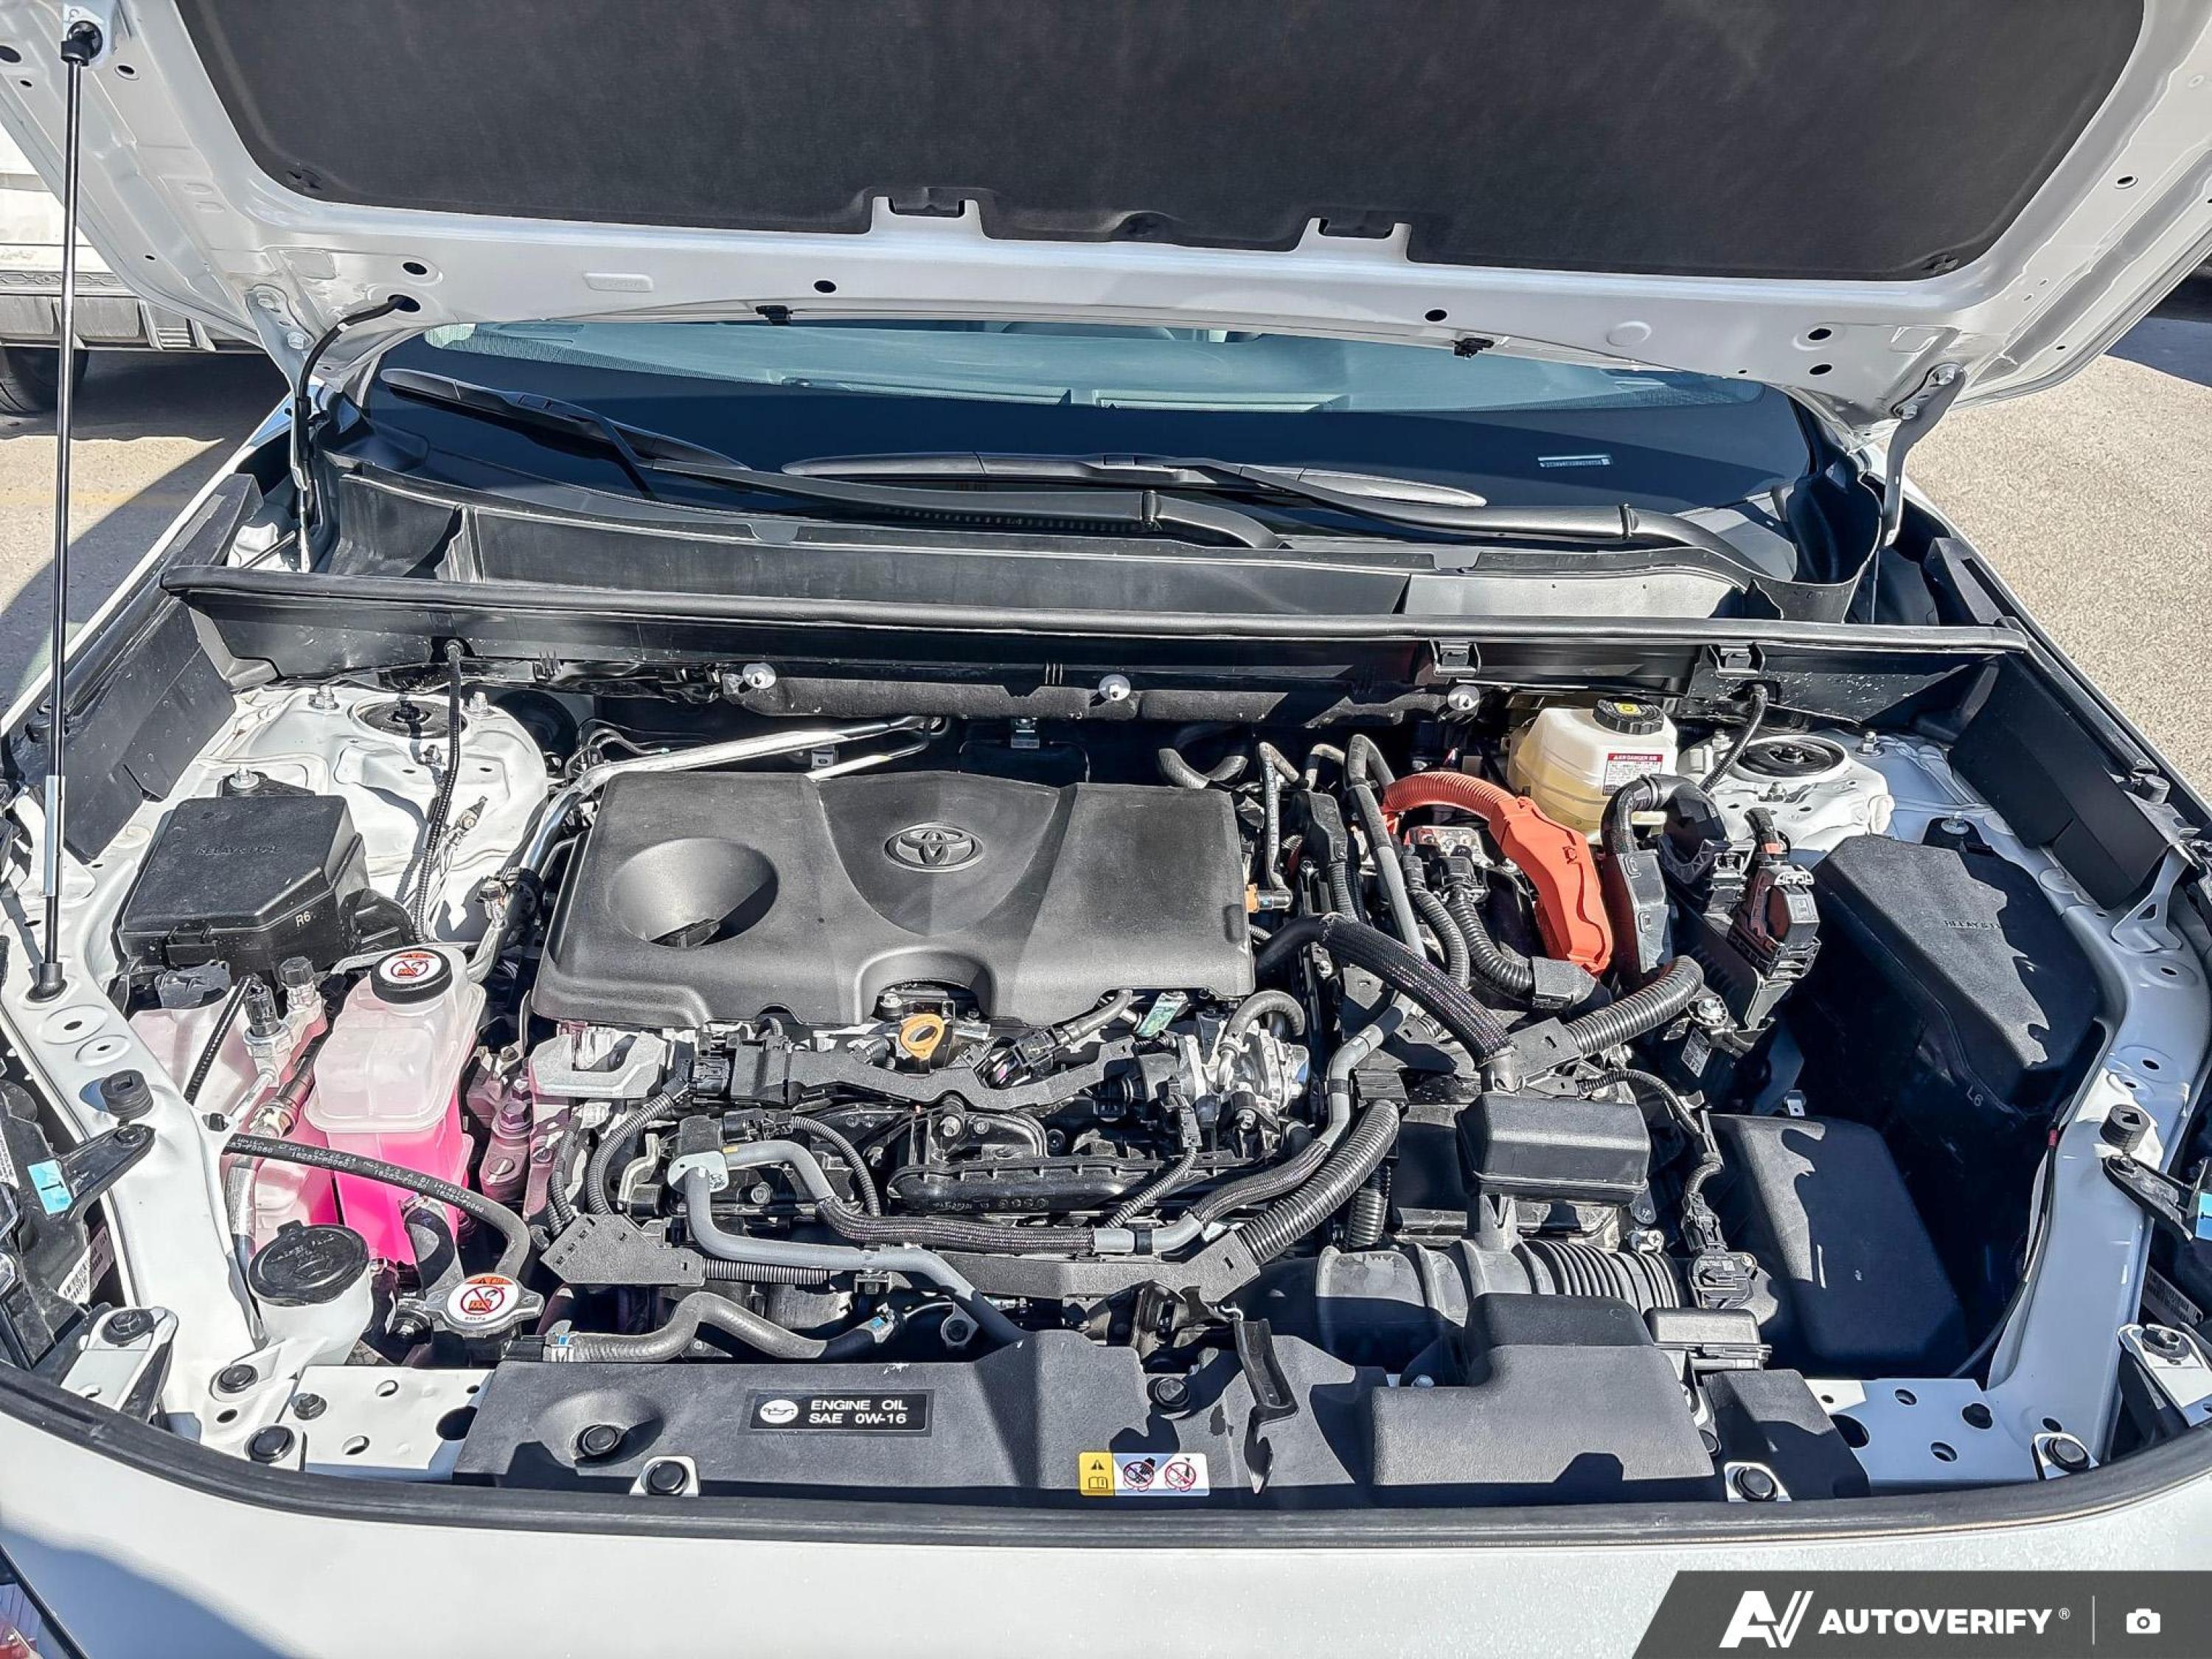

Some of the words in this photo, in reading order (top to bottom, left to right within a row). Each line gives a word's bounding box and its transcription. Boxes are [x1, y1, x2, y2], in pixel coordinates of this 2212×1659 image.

[296, 911, 311, 927] R6
[1966, 1085, 1983, 1107] L6
[810, 1399, 871, 1411] ENGINE
[881, 1399, 908, 1411] OIL
[809, 1413, 843, 1424] SAE
[855, 1413, 907, 1424] 0W-16
